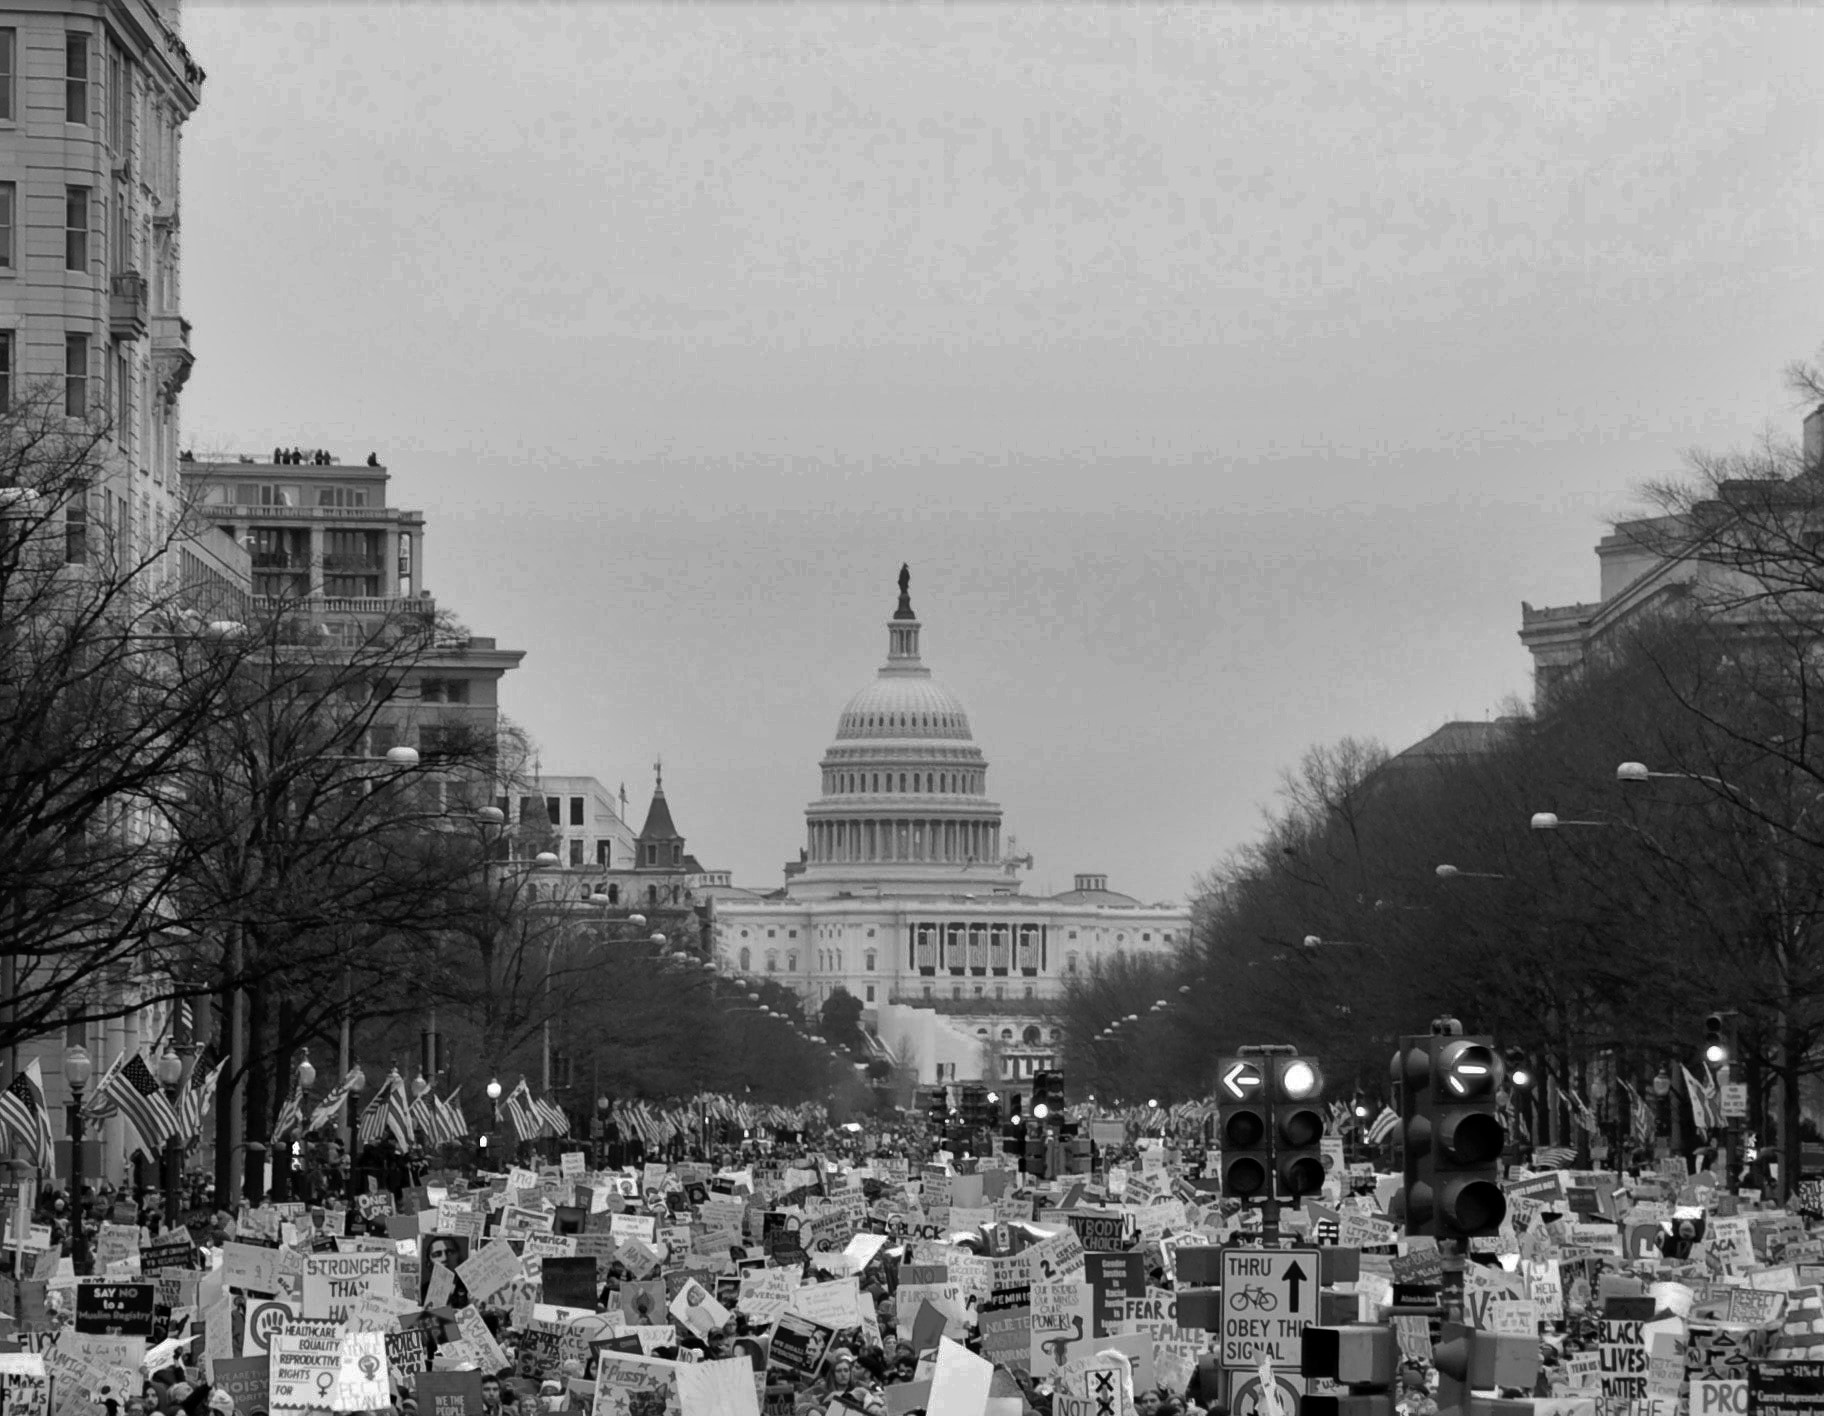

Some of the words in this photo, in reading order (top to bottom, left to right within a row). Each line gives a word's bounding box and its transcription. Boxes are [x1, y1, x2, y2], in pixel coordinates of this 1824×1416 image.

[306, 1257, 391, 1275] STRONGER
[1228, 1258, 1272, 1277] THRU
[93, 1287, 116, 1299] SAY
[118, 1288, 136, 1300] NO
[103, 1300, 115, 1310] to
[116, 1301, 124, 1310] a
[285, 1325, 337, 1339] HEALTHCARE
[1227, 1319, 1271, 1339] OBEY
[1599, 1321, 1644, 1345] BLACK
[299, 1339, 341, 1352] EQUALITY
[279, 1354, 341, 1368] REPRODUCTIVE
[1600, 1352, 1646, 1372] LIVES
[279, 1368, 310, 1382] RIGHTS
[275, 1385, 293, 1396] FOR
[1601, 1375, 1648, 1398] MATTER
